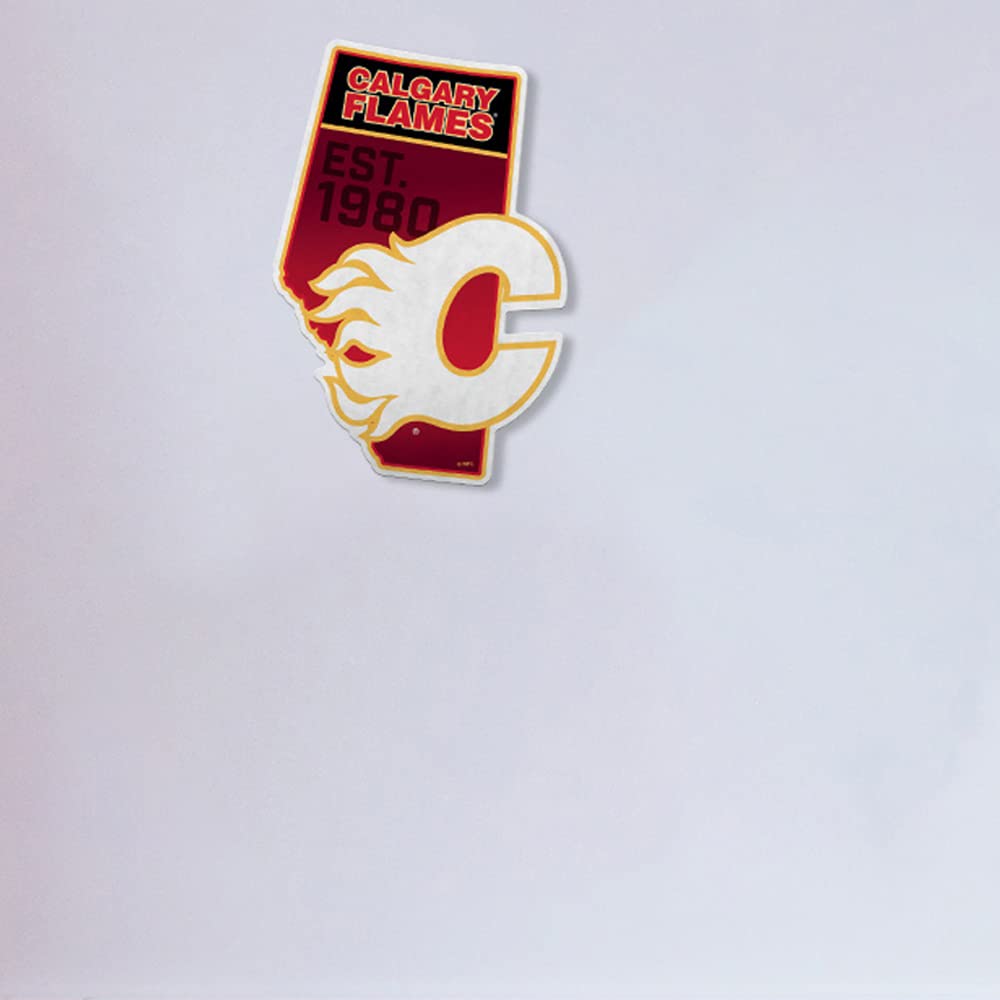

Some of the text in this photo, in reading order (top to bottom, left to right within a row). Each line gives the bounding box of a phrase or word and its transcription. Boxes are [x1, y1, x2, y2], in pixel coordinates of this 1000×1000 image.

[347, 66, 501, 112] CALGARY
[341, 91, 495, 142] FLAMES
[322, 141, 407, 188] EST.
[317, 181, 441, 238] 1980
